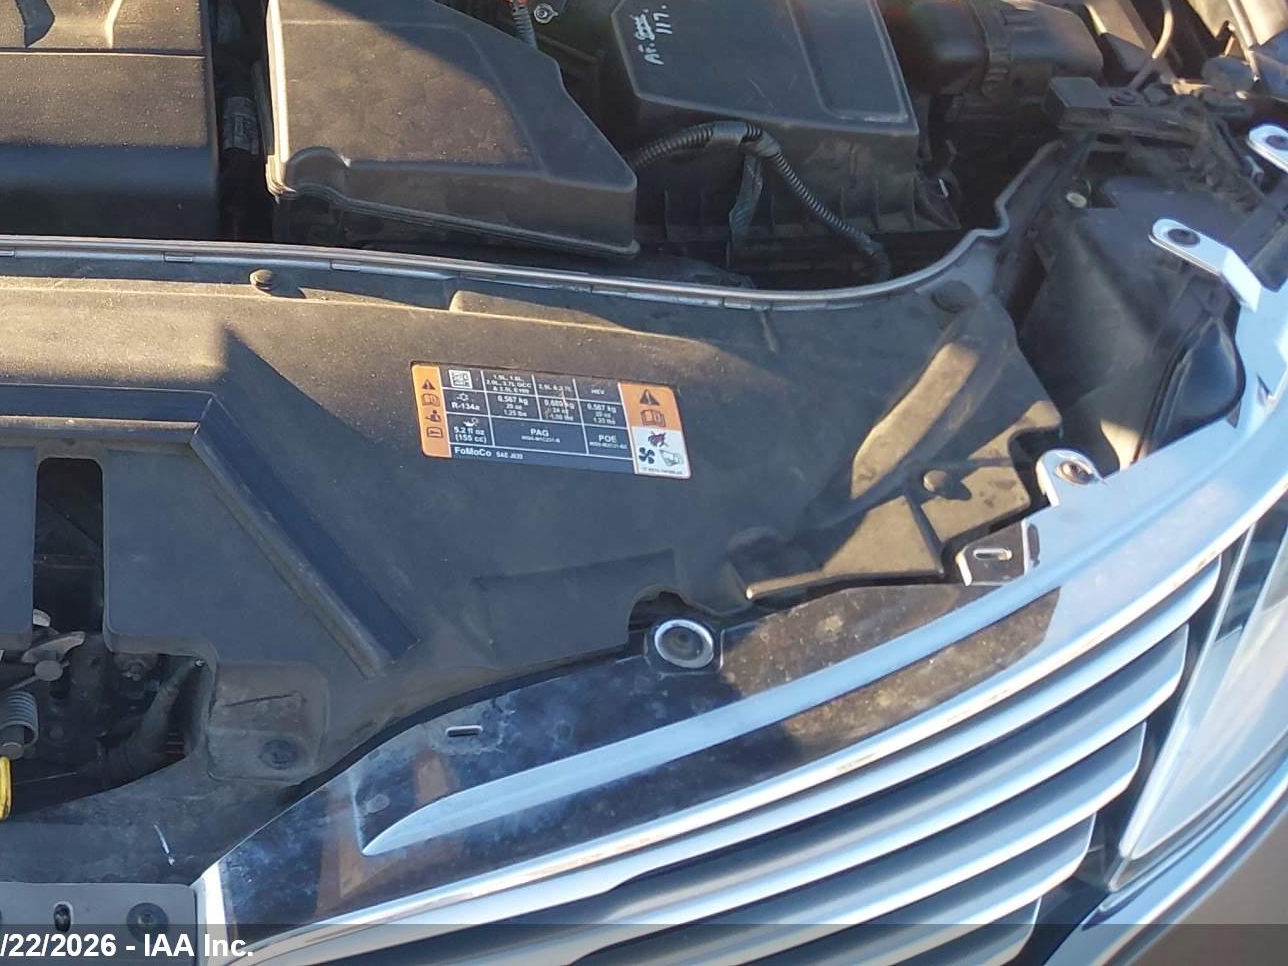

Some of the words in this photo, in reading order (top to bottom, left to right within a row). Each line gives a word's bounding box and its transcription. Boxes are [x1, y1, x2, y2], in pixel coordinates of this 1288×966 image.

[451, 402, 480, 411] R-134a
[454, 426, 466, 434] 5.2
[530, 428, 550, 437] PAG
[456, 434, 472, 442] (155
[474, 436, 487, 444] cc)
[598, 434, 617, 442] POE
[454, 446, 492, 457] FoMoCo
